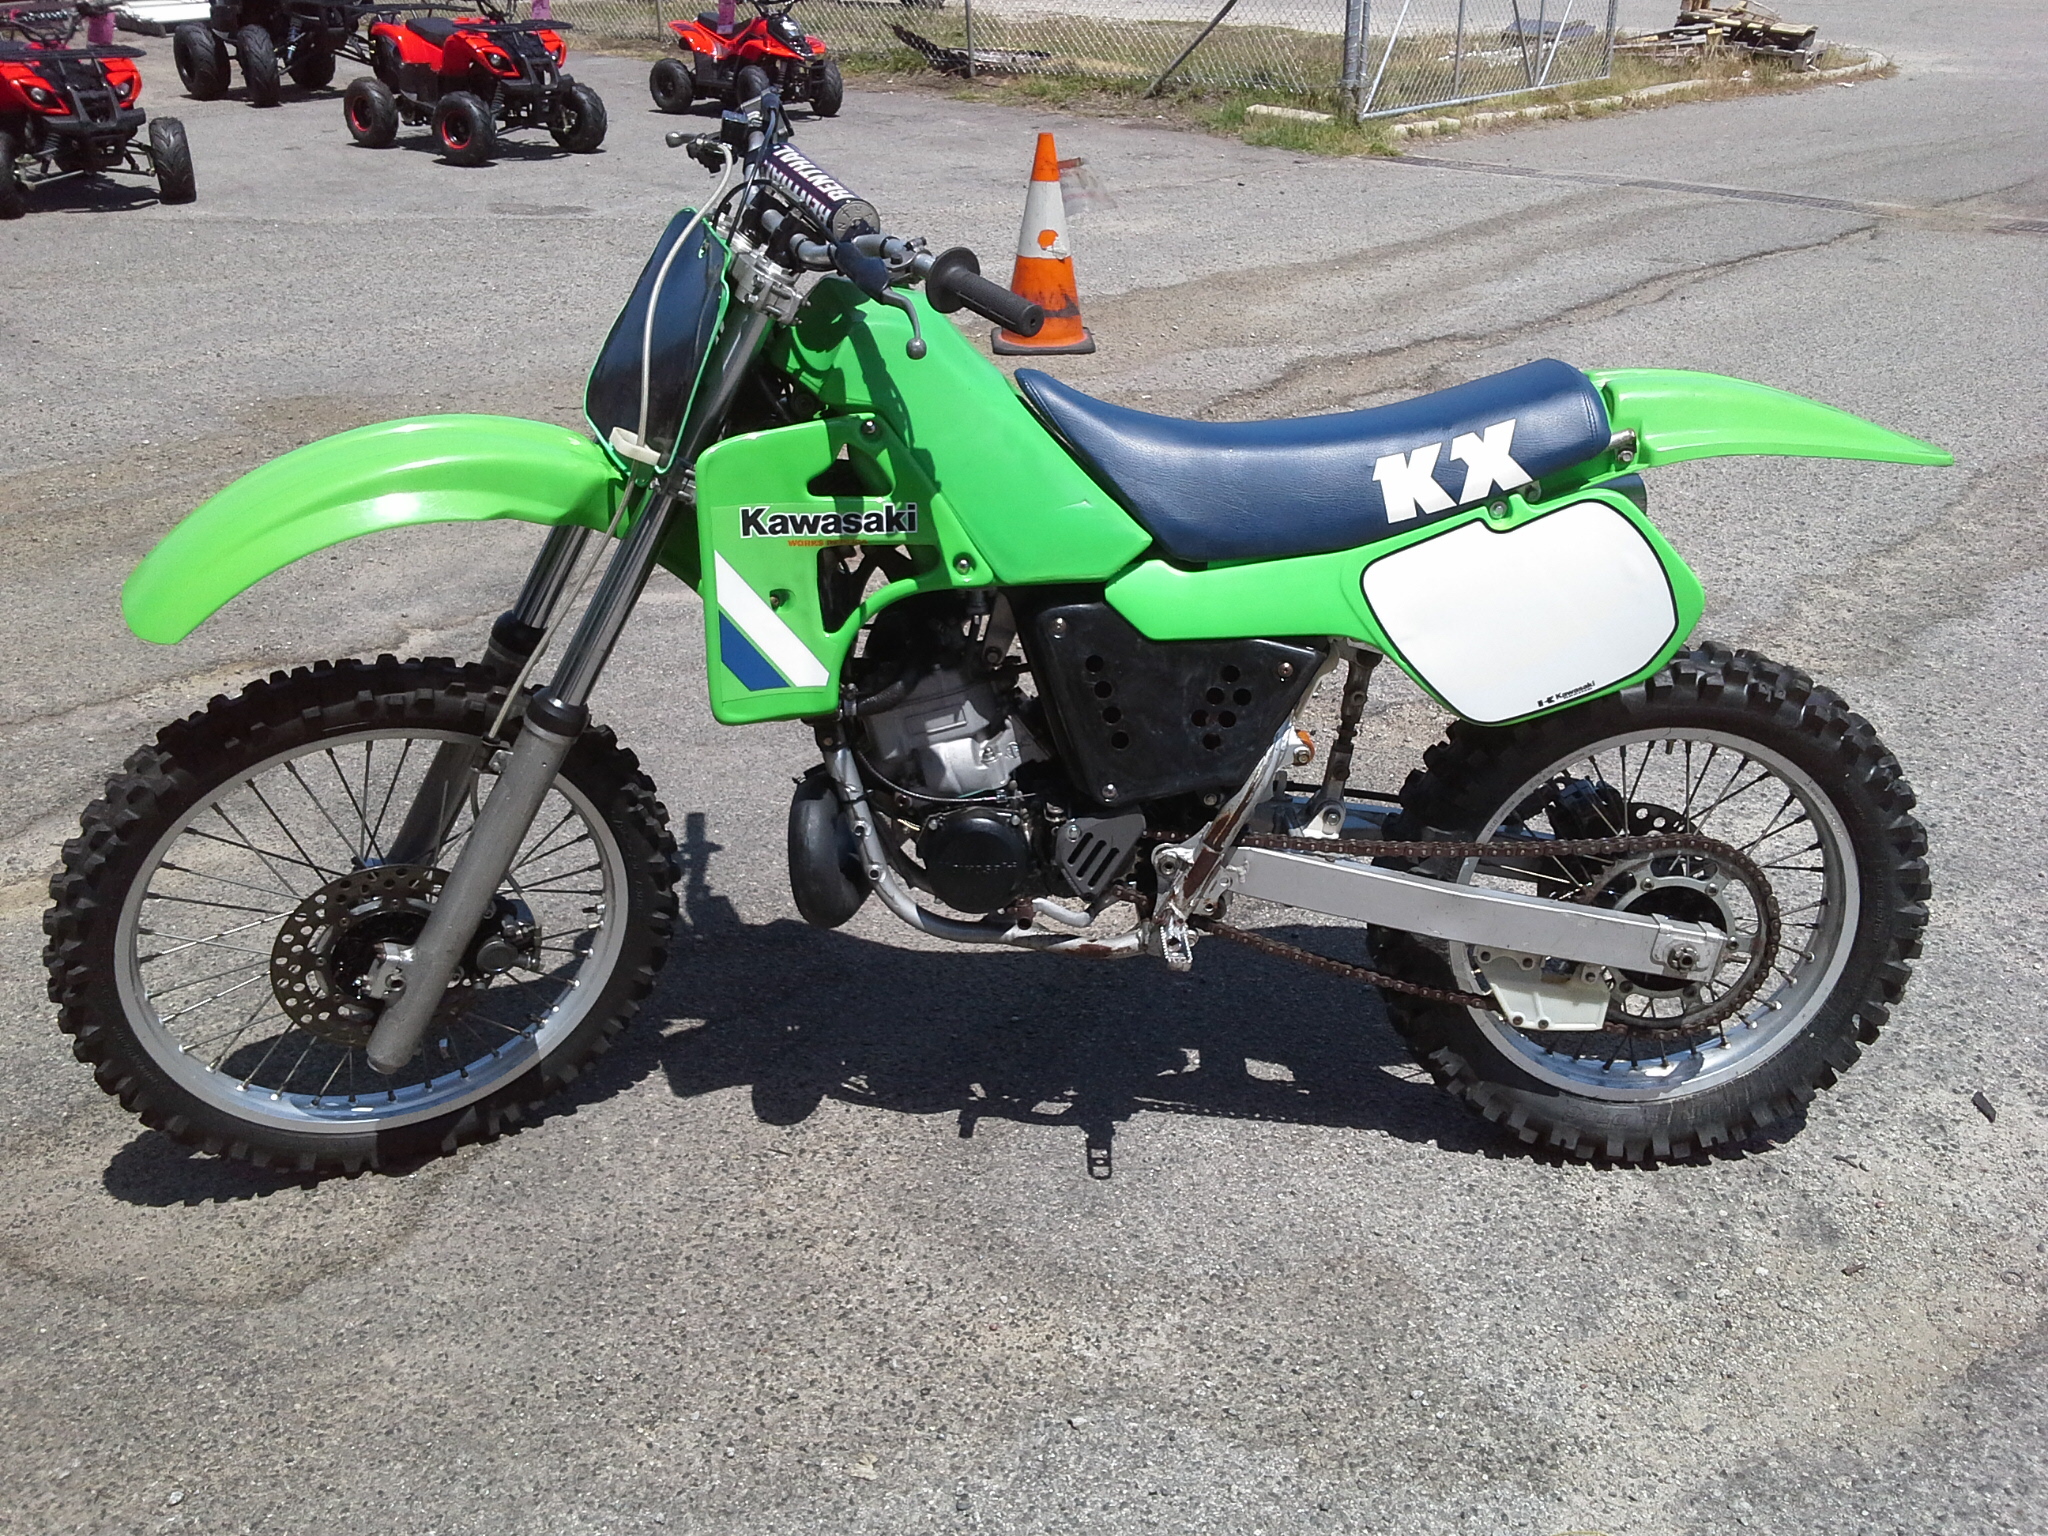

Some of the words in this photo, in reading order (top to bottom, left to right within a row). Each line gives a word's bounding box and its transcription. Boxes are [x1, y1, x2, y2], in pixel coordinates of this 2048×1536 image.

[773, 145, 856, 202] RENTHAL
[1372, 418, 1534, 524] KX
[740, 502, 917, 538] Kawasaki
[788, 539, 825, 547] WORKS
[1555, 680, 1596, 700] Kawasaki
